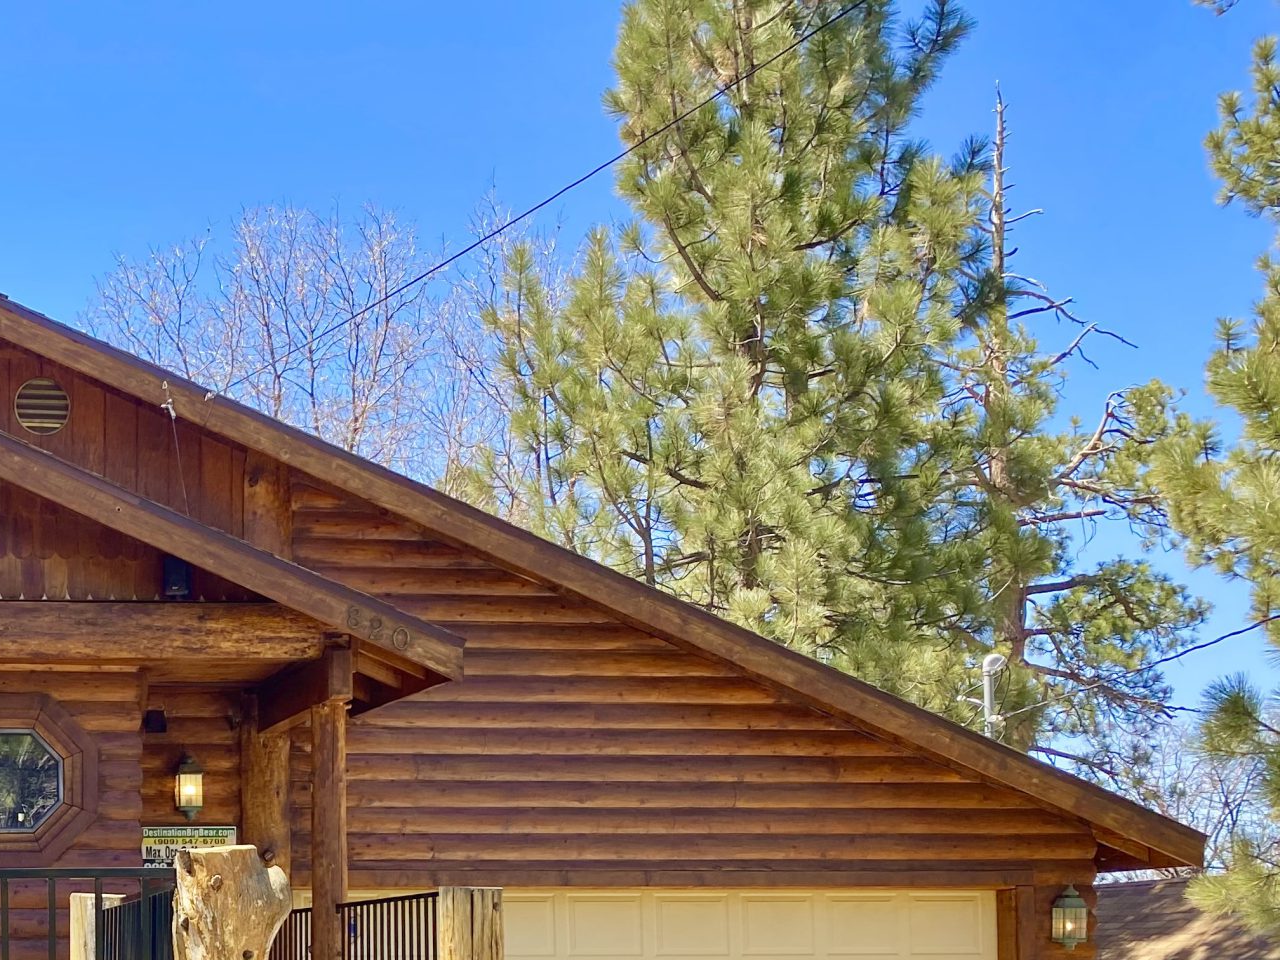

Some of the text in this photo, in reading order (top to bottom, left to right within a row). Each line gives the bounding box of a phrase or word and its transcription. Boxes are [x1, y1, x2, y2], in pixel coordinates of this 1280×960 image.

[346, 605, 410, 650] 820
[143, 828, 234, 838] DestinationBigBear.com
[145, 846, 164, 858] Max.
